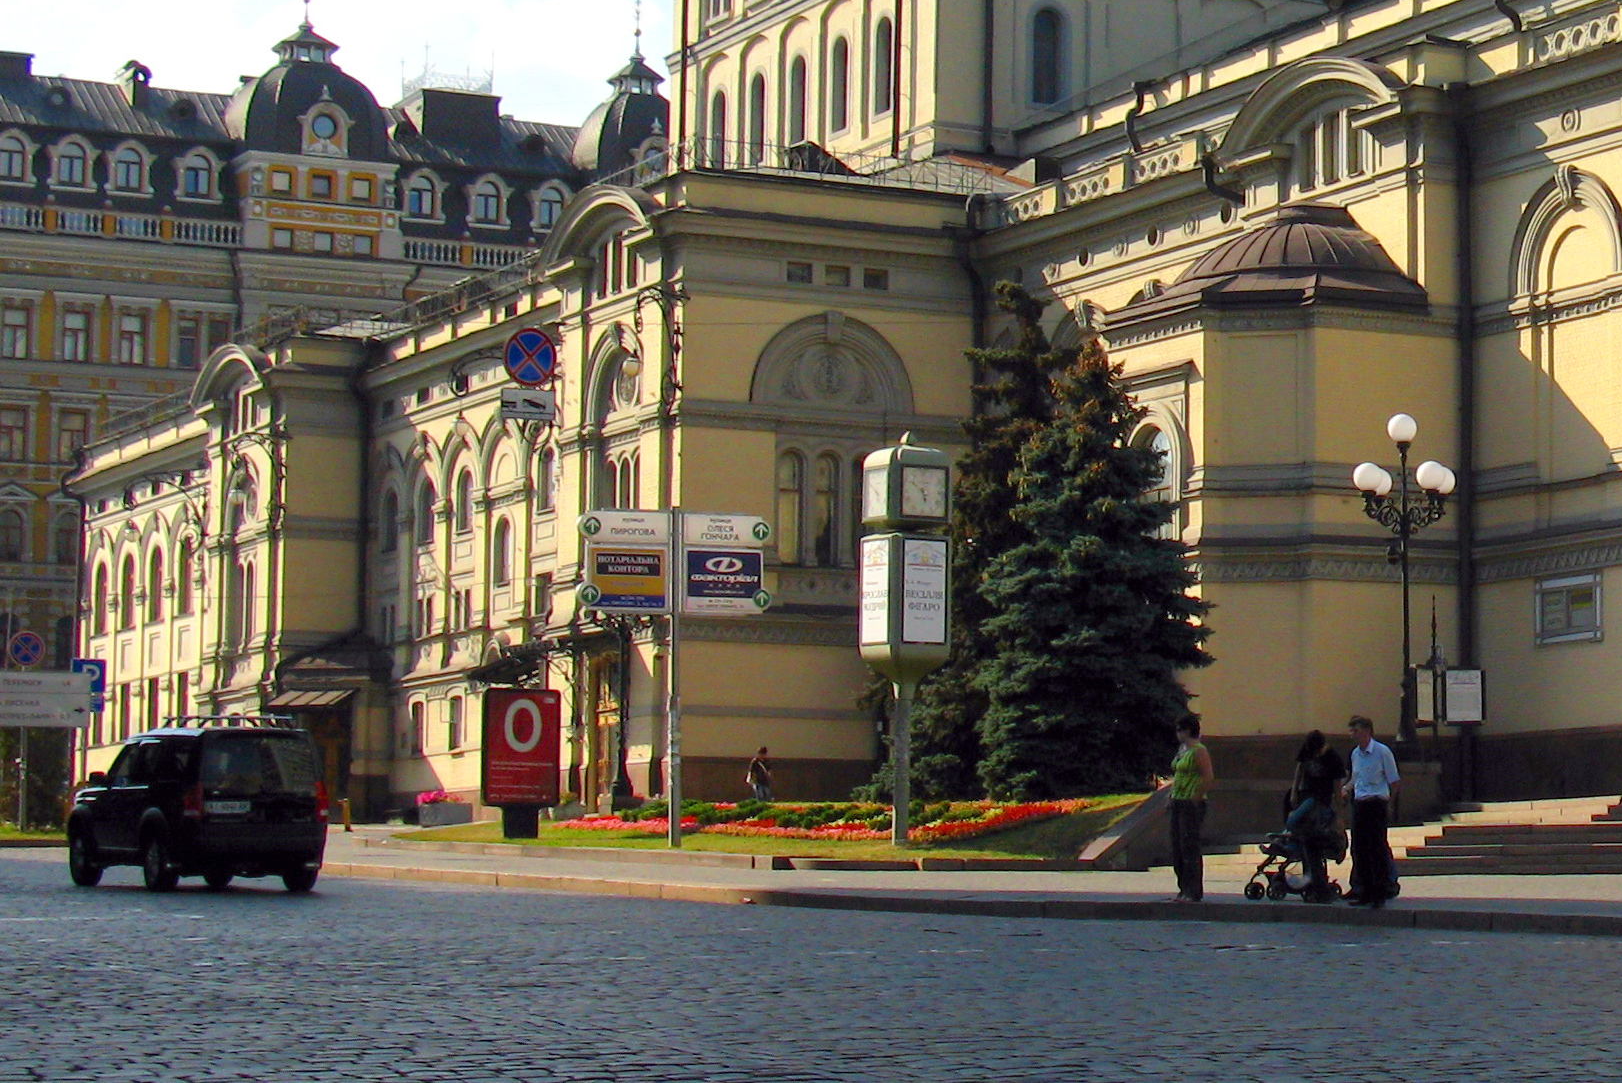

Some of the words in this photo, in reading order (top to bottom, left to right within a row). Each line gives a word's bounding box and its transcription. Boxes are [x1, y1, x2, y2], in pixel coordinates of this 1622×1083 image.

[610, 527, 656, 536] ПИРОГОВА
[707, 525, 734, 533] ОЛЕСЯ
[700, 532, 740, 541] ГОНЧАРА
[607, 564, 650, 574] КОНТОРА
